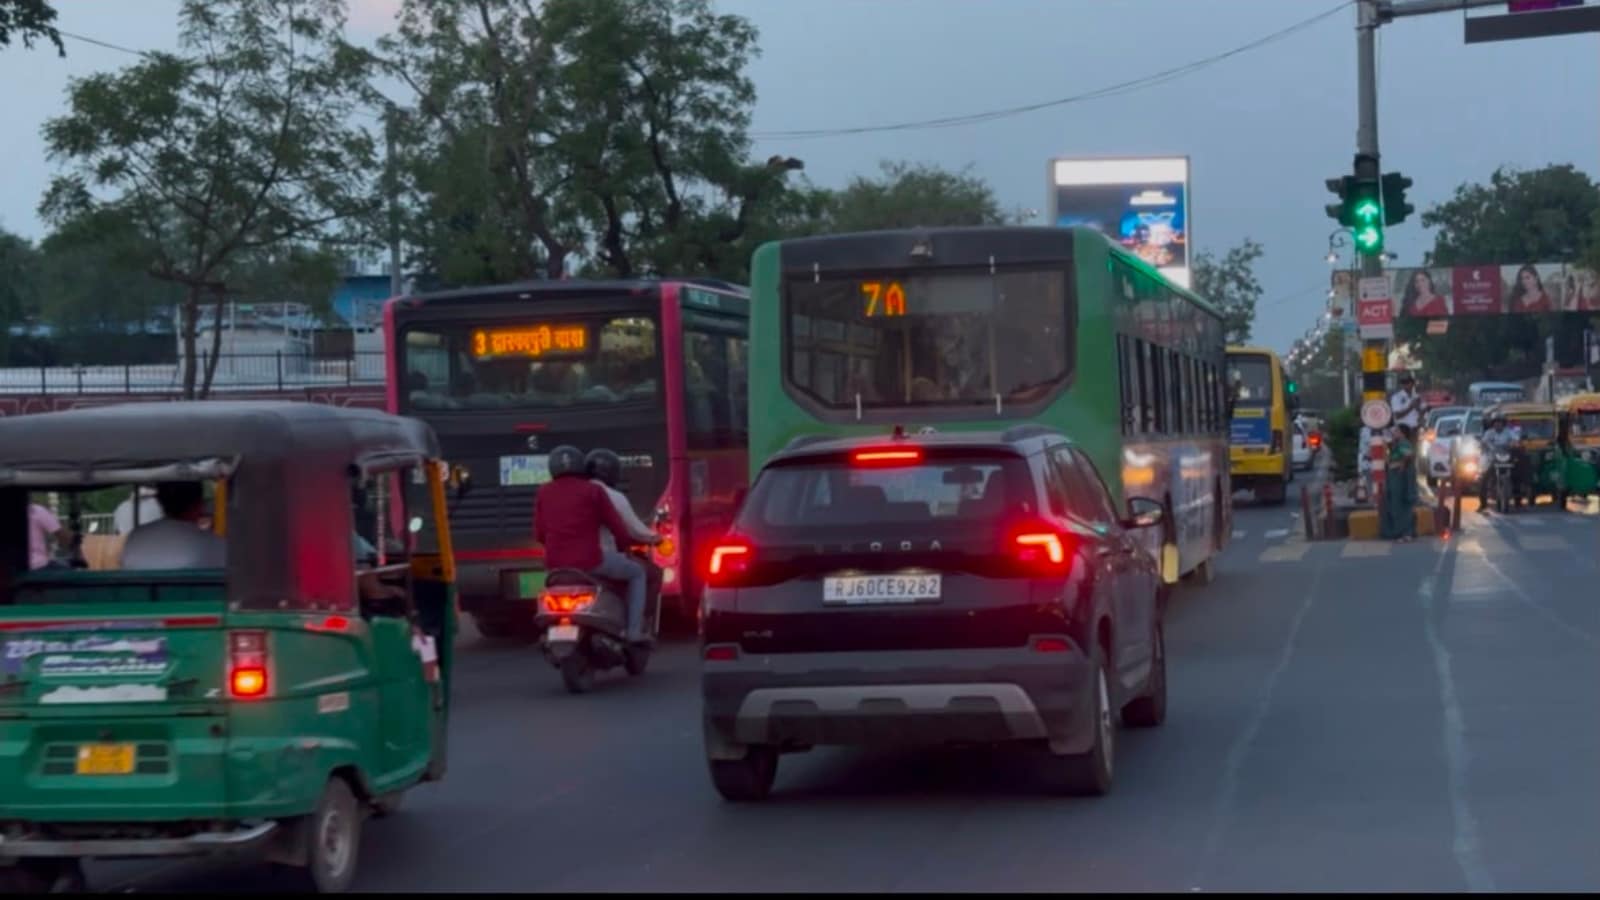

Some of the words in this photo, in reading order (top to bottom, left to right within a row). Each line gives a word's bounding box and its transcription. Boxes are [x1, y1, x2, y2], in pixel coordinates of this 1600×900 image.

[860, 281, 905, 317] 7A
[1361, 303, 1389, 318] ACT
[475, 331, 486, 355] 3
[815, 540, 944, 554] ODA
[834, 577, 938, 597] RJ60CE9282
